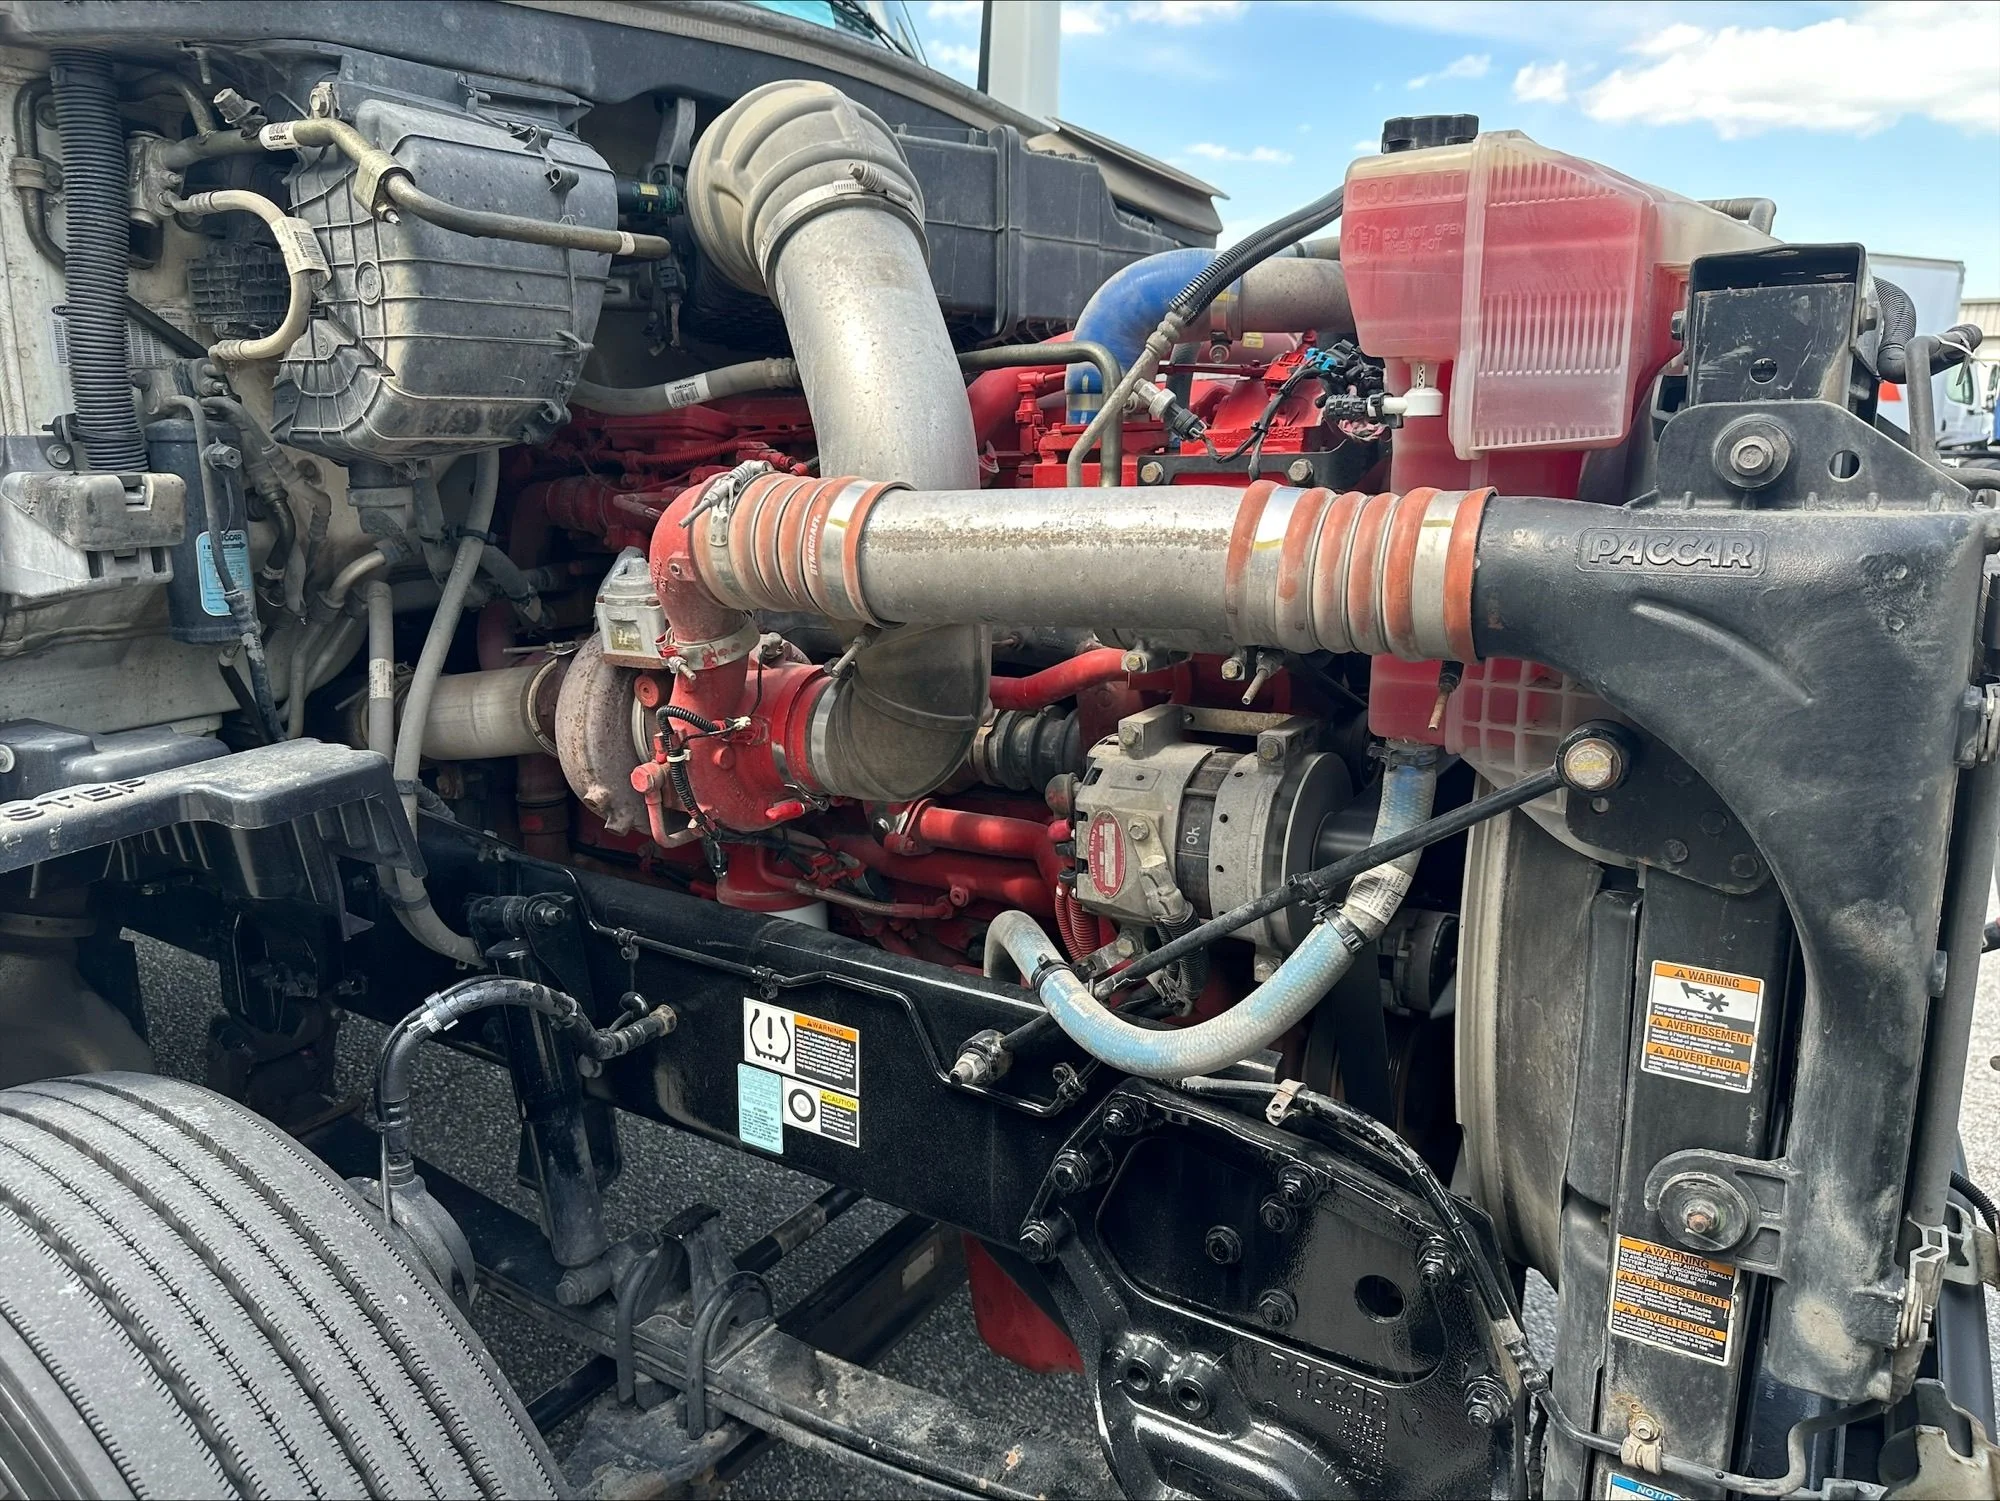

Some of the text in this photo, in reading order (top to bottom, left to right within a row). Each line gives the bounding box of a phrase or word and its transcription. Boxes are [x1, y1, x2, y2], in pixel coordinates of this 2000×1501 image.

[1352, 174, 1462, 205] COOLANT
[1382, 222, 1465, 240] DO NOT OPEN
[1420, 236, 1443, 250] HOT
[1588, 532, 1753, 569] PACCAR
[2, 779, 146, 821] STEP
[1089, 827, 1098, 880] Delco Remy
[1687, 970, 1740, 988] WARNING
[812, 1021, 843, 1036] WARNING
[1665, 1019, 1751, 1044] AVERTISSEMENT
[1667, 1047, 1742, 1071] ADVERTENCIA
[826, 1093, 856, 1109] CAUTION
[1652, 1246, 1709, 1269] WARNING
[1663, 1258, 1682, 1267] START
[1646, 1263, 1667, 1273] POWER
[1677, 1271, 1689, 1279] THE
[1689, 1274, 1717, 1287] STARTER
[1629, 1273, 1726, 1307] AVERTISSEMENT
[1634, 1307, 1716, 1338] ADVERTENCIA
[1637, 1485, 1679, 1501] NOTIC
